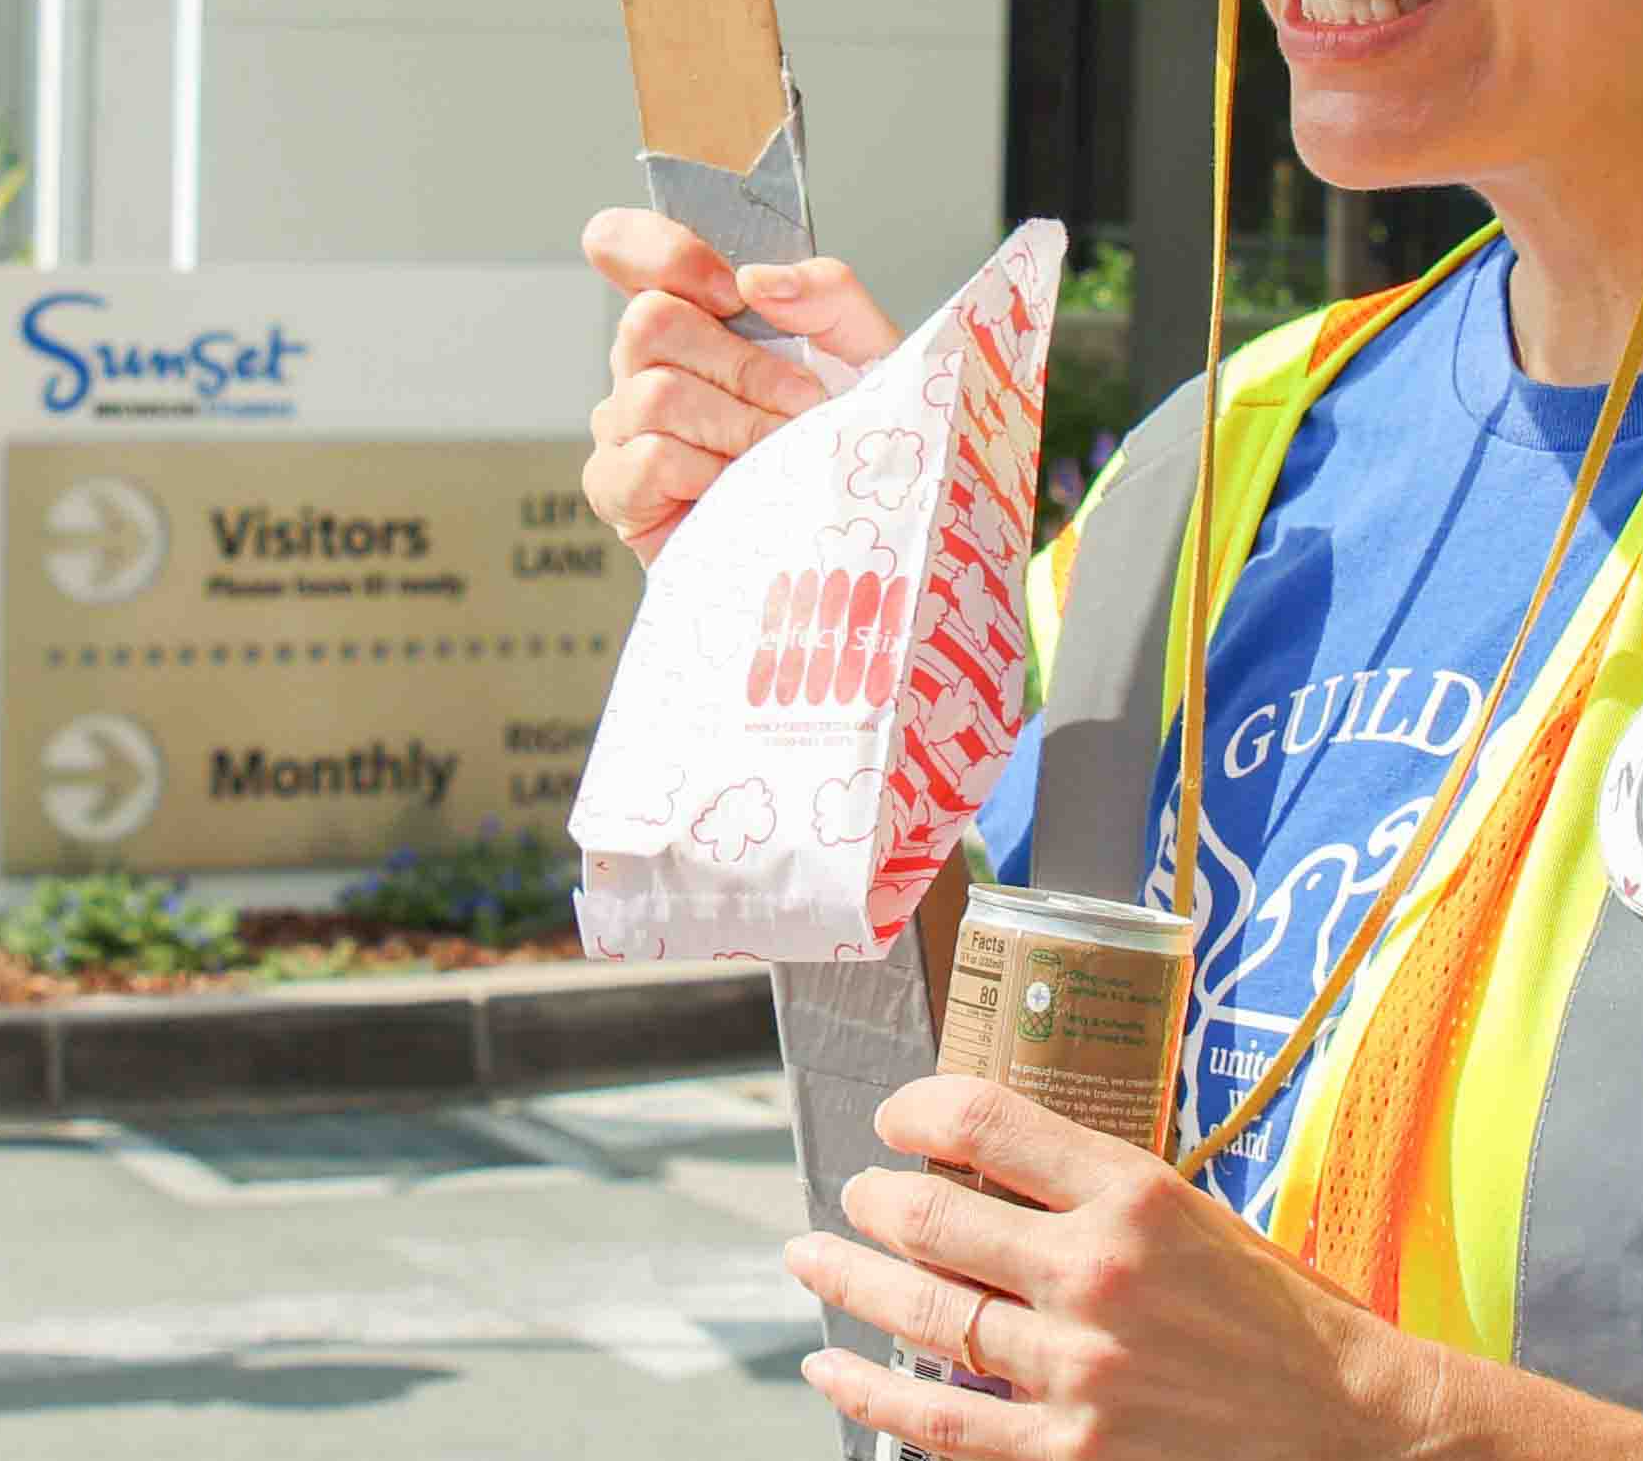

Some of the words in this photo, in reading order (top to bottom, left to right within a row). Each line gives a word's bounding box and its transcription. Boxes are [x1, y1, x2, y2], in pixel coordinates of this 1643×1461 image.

[208, 506, 431, 560] Visitors
[1225, 667, 1484, 779] GUILD
[208, 741, 457, 807] Monthly
[971, 930, 1005, 953] Facts
[979, 985, 998, 1007] 80
